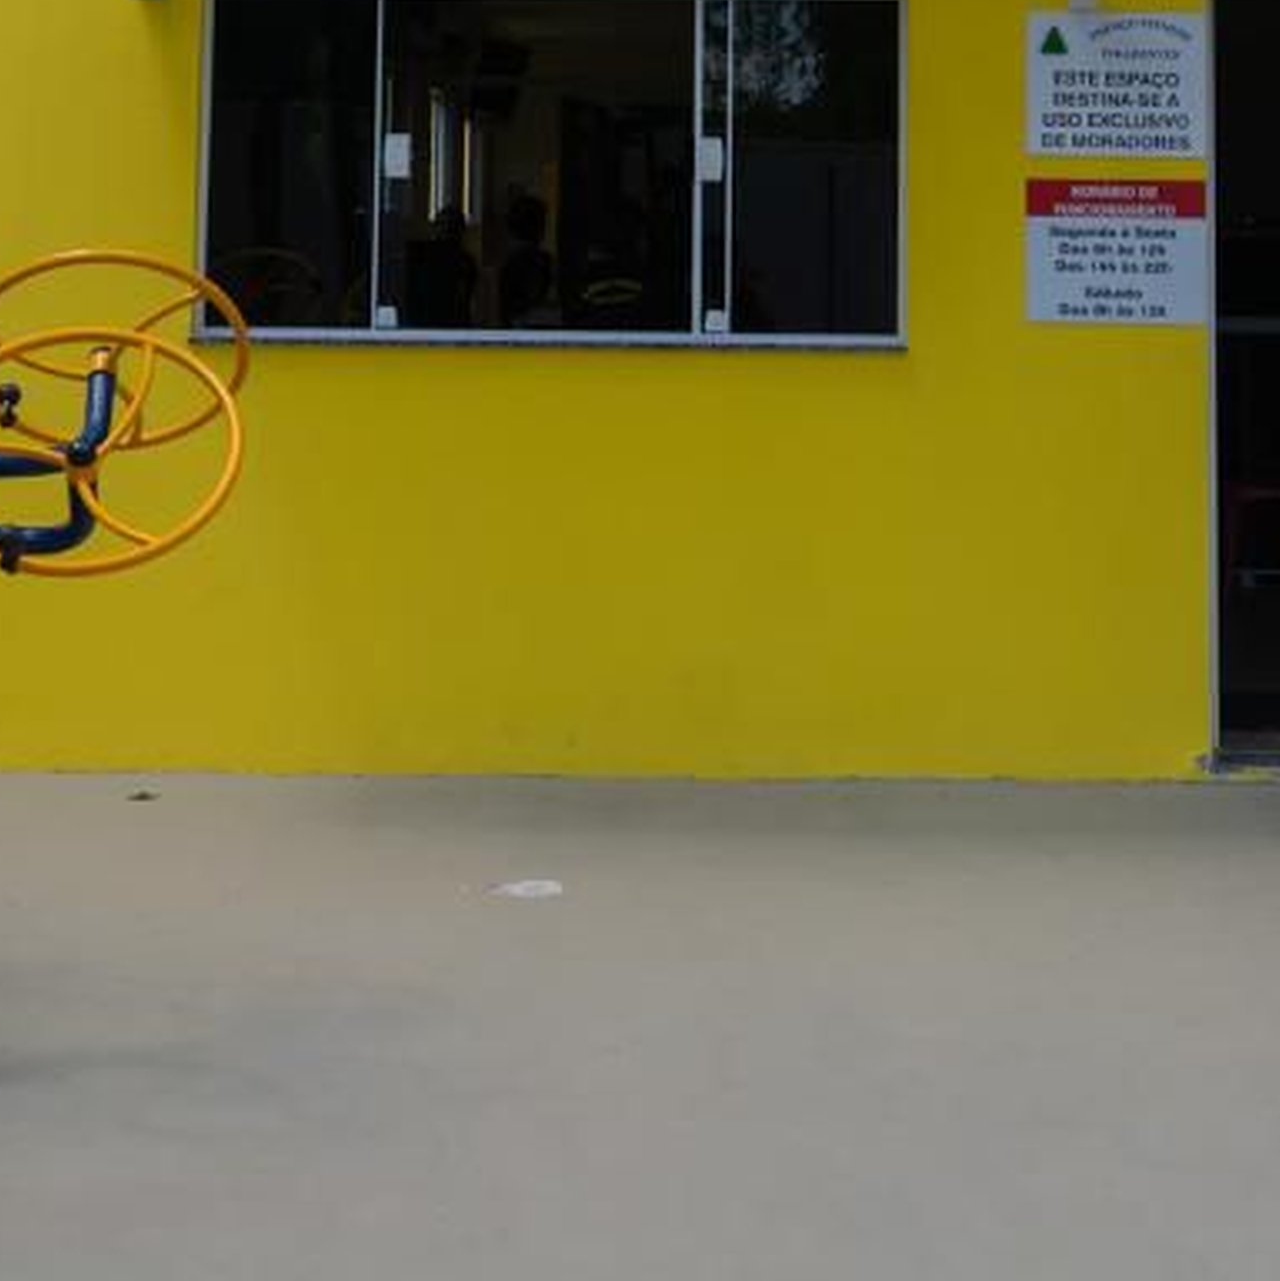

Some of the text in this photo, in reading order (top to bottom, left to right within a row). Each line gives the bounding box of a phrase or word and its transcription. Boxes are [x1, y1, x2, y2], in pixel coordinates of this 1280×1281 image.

[1052, 71, 1181, 89] ESTE ESPAÇO
[1052, 92, 1162, 107] DESTINA-SE
[1041, 113, 1191, 130] USO EXCLUSIVO
[1041, 133, 1192, 150] DE MORADORES
